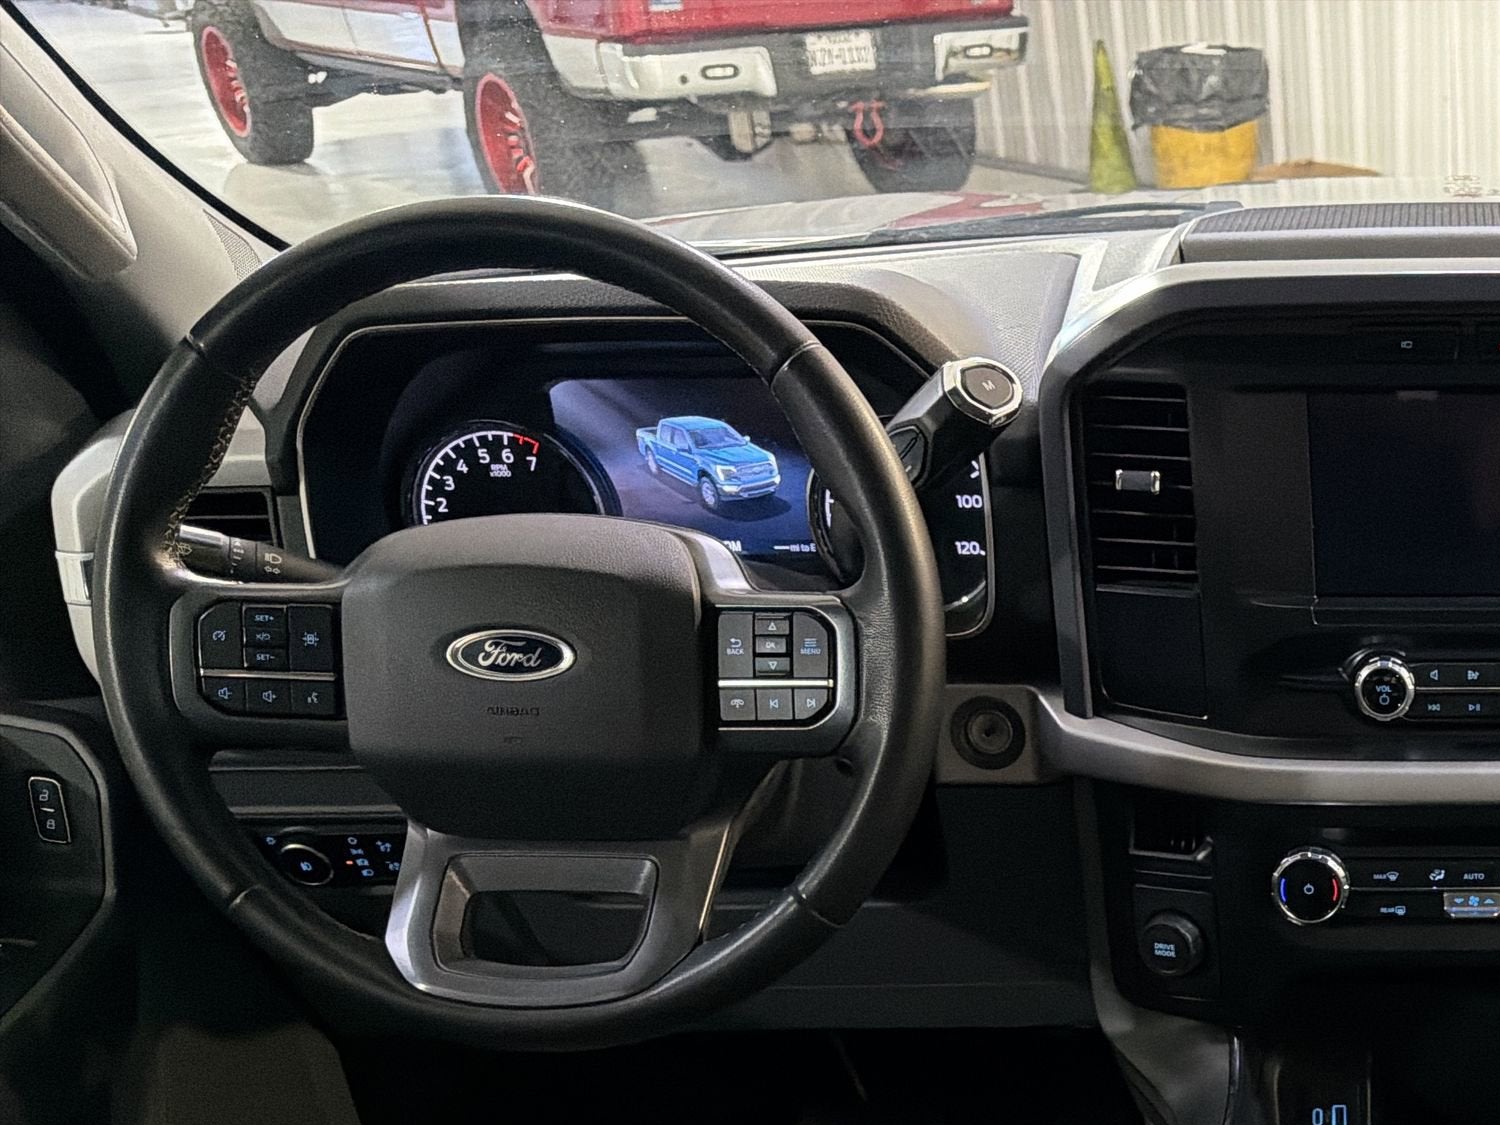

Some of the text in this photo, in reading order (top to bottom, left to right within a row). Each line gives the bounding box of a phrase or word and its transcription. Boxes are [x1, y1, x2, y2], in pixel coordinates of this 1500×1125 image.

[981, 379, 996, 392] M
[477, 448, 491, 464] 5
[501, 448, 515, 464] 6
[456, 459, 469, 474] 4
[525, 456, 537, 472] 7
[442, 475, 456, 491] 3
[436, 497, 449, 513] 2
[955, 494, 983, 509] 100
[954, 541, 980, 555] 120
[726, 648, 745, 656] BACK
[765, 641, 776, 649] OK
[800, 648, 822, 656] MENU
[477, 638, 543, 668] Ford
[1375, 685, 1392, 693] VOL
[1463, 871, 1485, 880] AUTO
[1153, 942, 1176, 951] DRIVE
[1154, 949, 1177, 958] MODE
